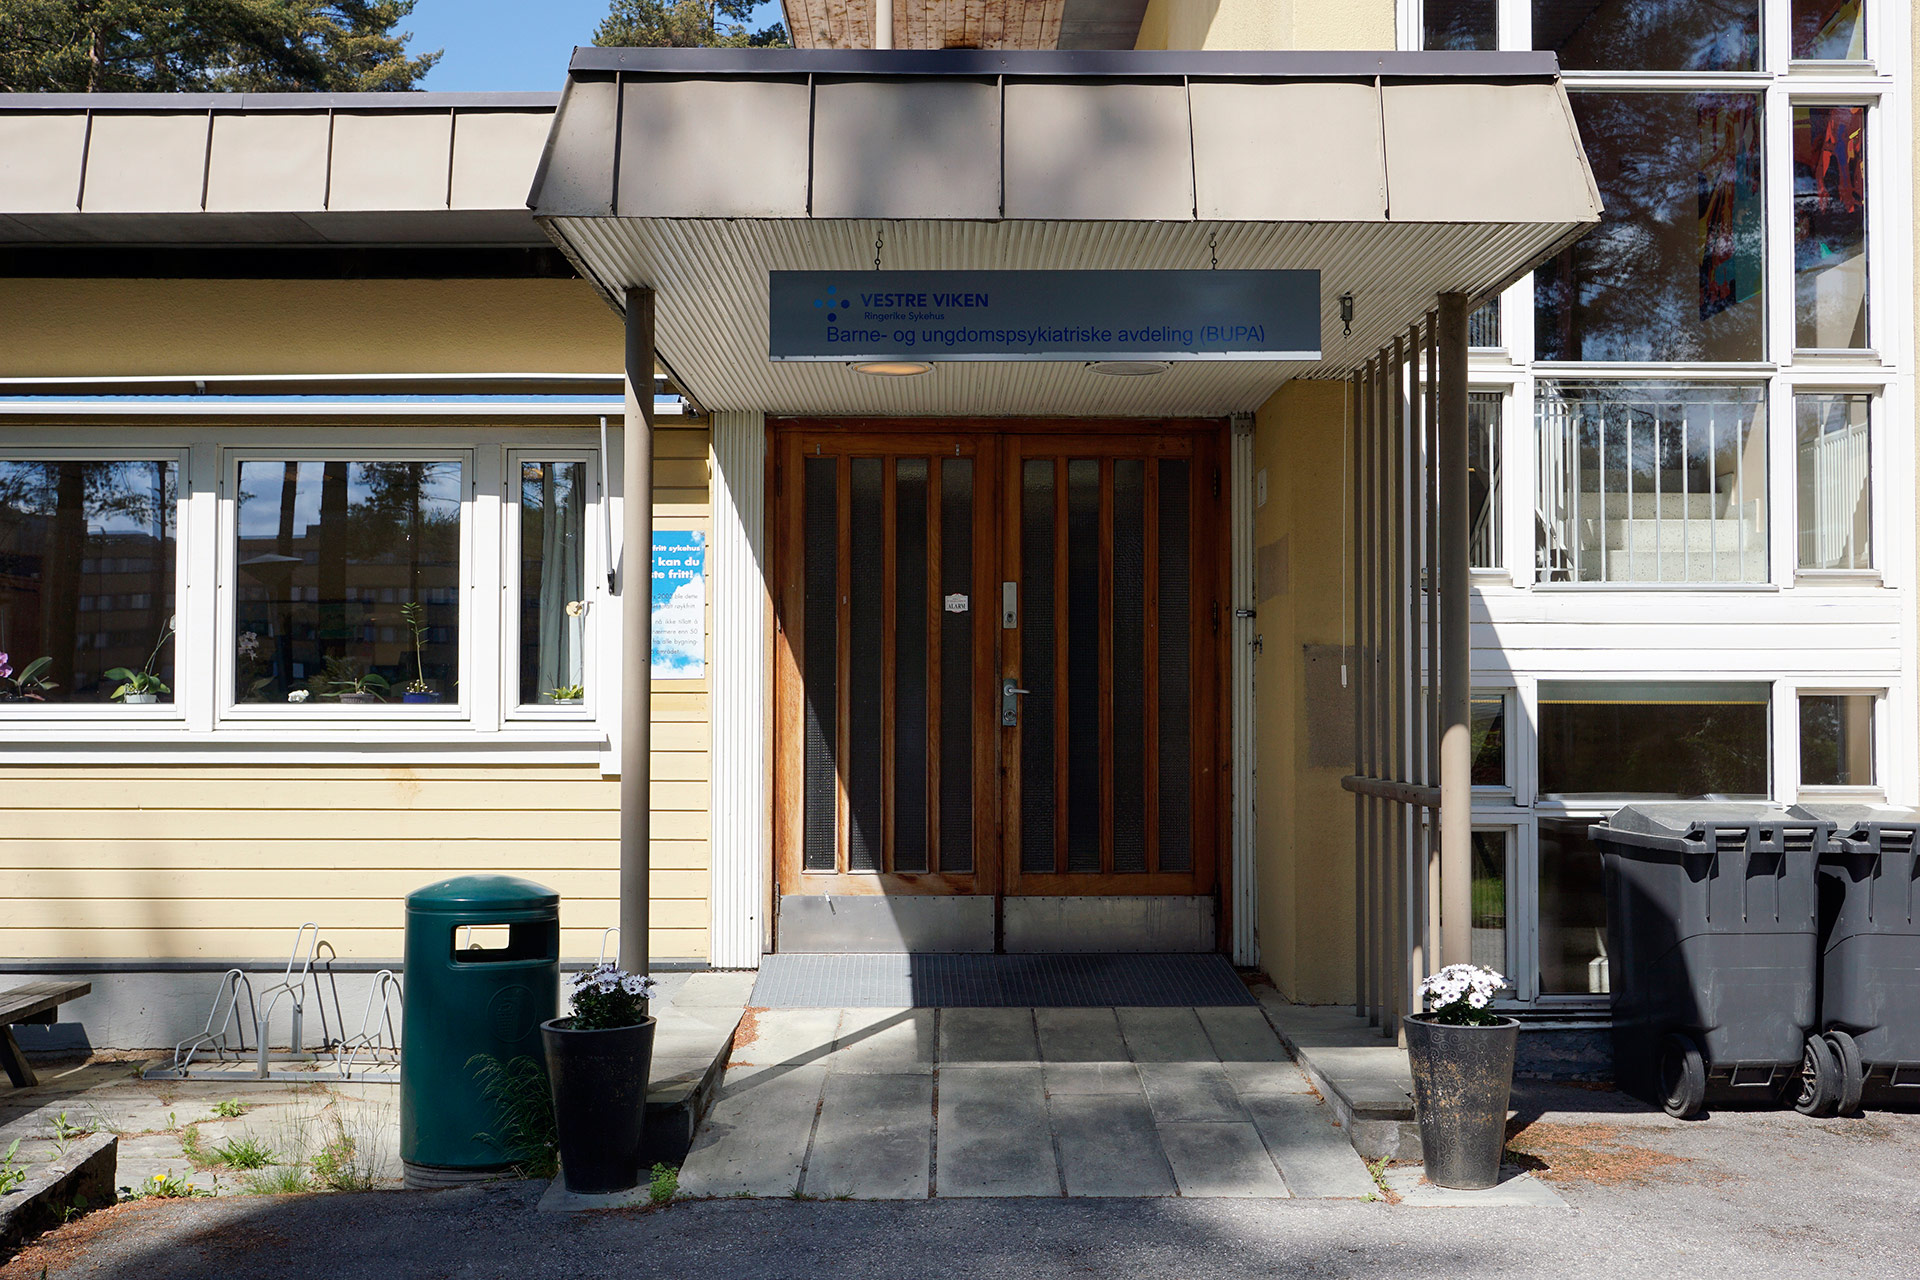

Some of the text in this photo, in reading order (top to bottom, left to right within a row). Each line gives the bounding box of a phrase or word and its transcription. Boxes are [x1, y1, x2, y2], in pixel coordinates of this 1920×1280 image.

[860, 293, 988, 308] VESTRE VIKEN
[864, 311, 945, 322] Ringerike Sykehus
[827, 325, 1264, 346] Barne- og ungdomspsykiatriske avdeling (BUPA)
[668, 544, 700, 553] sykehus
[658, 556, 700, 566] kan du
[668, 569, 694, 578] fritt!
